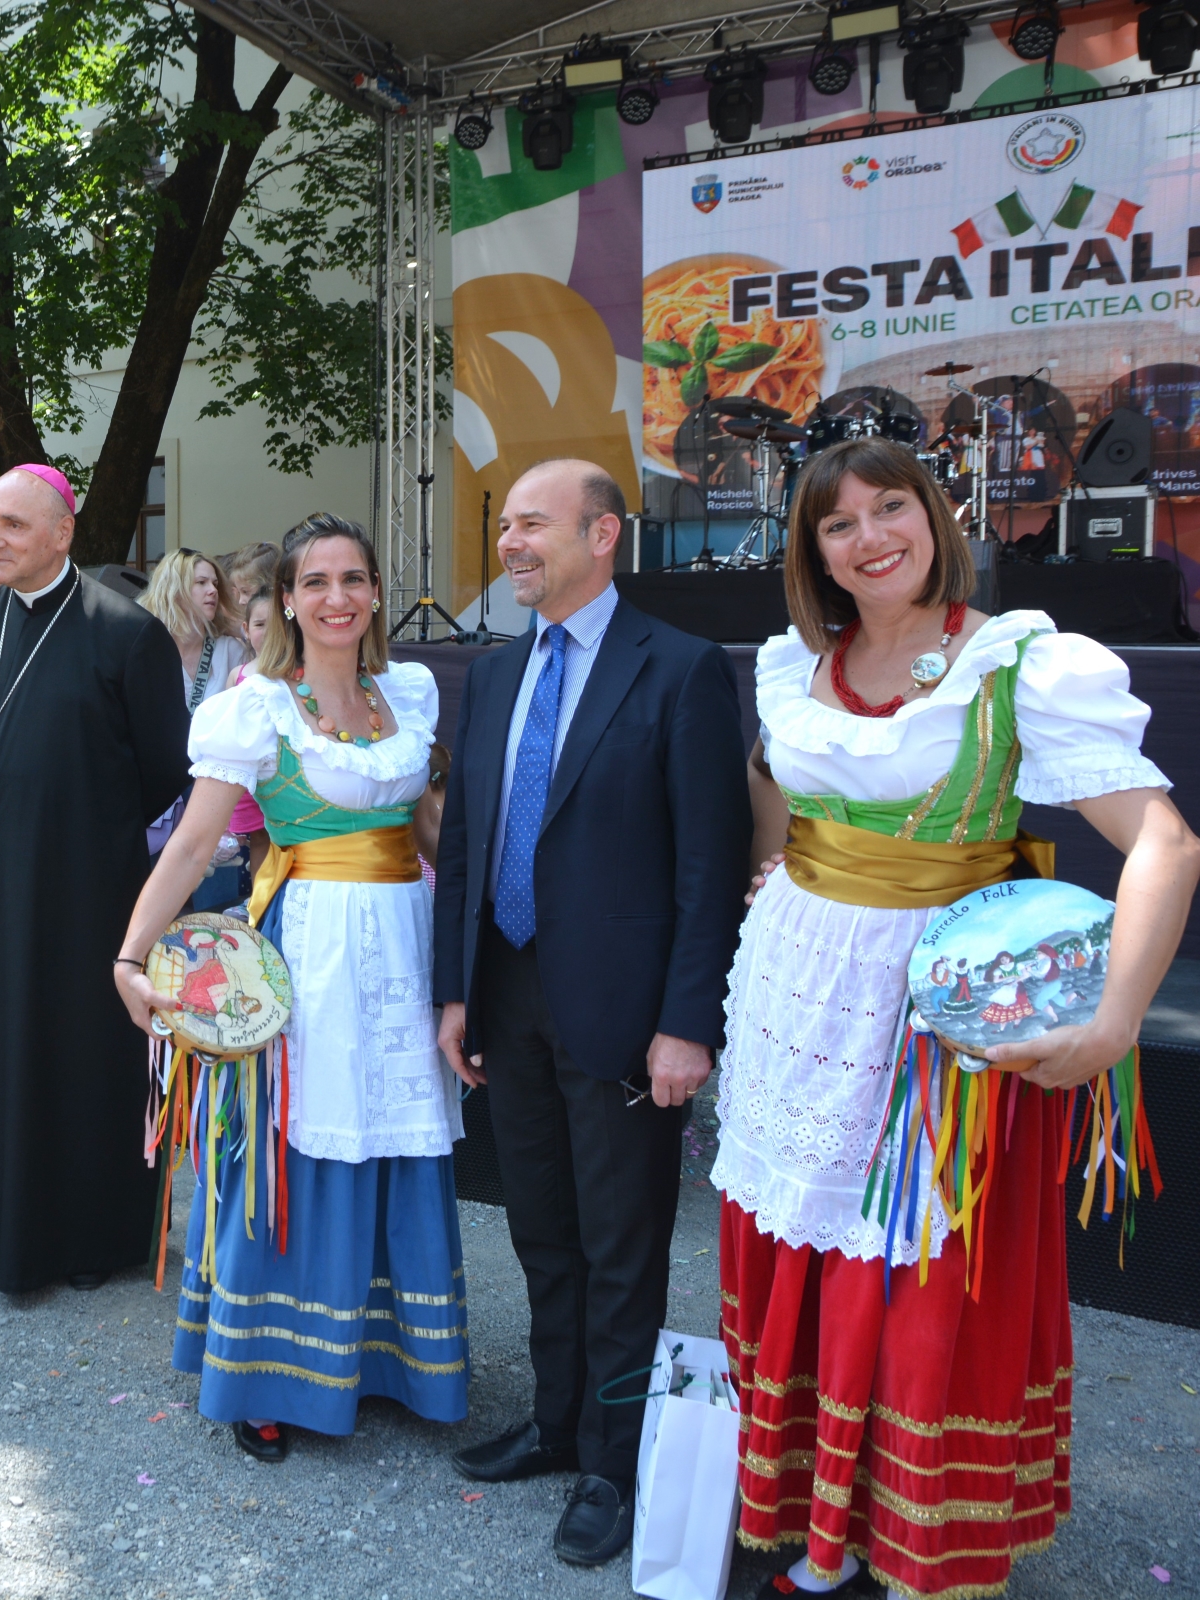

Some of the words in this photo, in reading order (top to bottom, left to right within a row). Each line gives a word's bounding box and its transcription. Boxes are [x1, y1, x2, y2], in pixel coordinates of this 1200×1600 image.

[1010, 118, 1043, 145] ITALIANI
[728, 183, 784, 194] MUNICIPIULUI
[728, 194, 761, 203] ORADEA
[732, 255, 974, 323] FESTA
[1011, 295, 1143, 324] CETATEA
[1151, 289, 1200, 311] OR
[831, 320, 877, 341] 6-8
[884, 313, 956, 336] IUNIE
[707, 489, 753, 499] Michele
[707, 500, 753, 510] Roscico
[198, 636, 216, 674] GOTTA
[190, 677, 207, 708] HAVE
[922, 905, 970, 946] Sorrento
